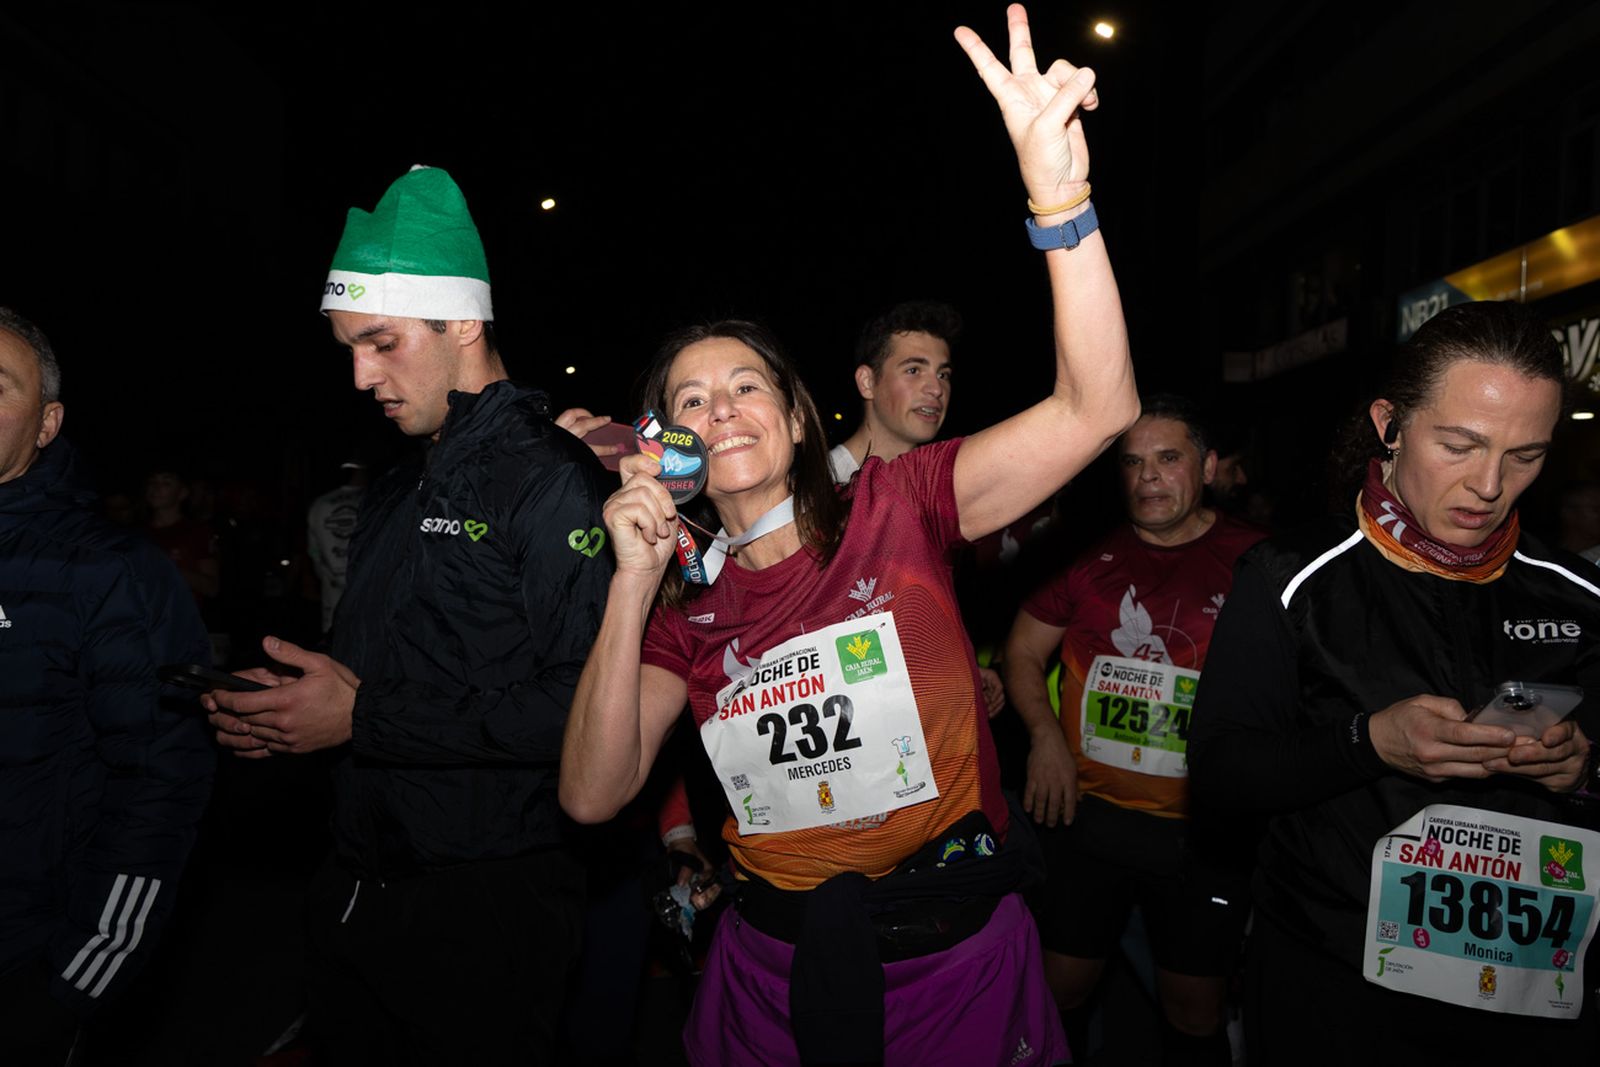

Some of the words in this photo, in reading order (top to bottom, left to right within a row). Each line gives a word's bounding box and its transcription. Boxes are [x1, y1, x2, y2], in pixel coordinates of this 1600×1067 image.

[323, 281, 345, 296] ano
[662, 432, 694, 446] 2026
[664, 456, 684, 473] 43
[662, 480, 695, 490] NISHER
[419, 517, 461, 535] sano
[866, 591, 894, 610] RURAL
[1503, 619, 1582, 641] tone
[750, 659, 794, 687] OCHE
[797, 653, 820, 673] DE
[1112, 669, 1148, 684] NOCHE
[1149, 674, 1164, 687] DE
[719, 692, 756, 720] SAN
[760, 673, 825, 710] ANTÓN
[1097, 679, 1120, 693] SAN
[1121, 685, 1163, 701] ANTÓN
[1097, 695, 1189, 740] 12524
[756, 694, 863, 766] 232
[787, 757, 852, 781] MERCEDES
[1428, 816, 1454, 827] CARRERA
[1454, 820, 1478, 830] URBANA
[1479, 824, 1521, 838] INTERNACIONAL
[1427, 824, 1495, 851] NOCHE
[1498, 835, 1521, 855] DE
[1399, 843, 1445, 869] SAN
[1448, 852, 1521, 882] ANTÓN
[1400, 870, 1576, 949] 13854
[1464, 942, 1513, 963] Monica
